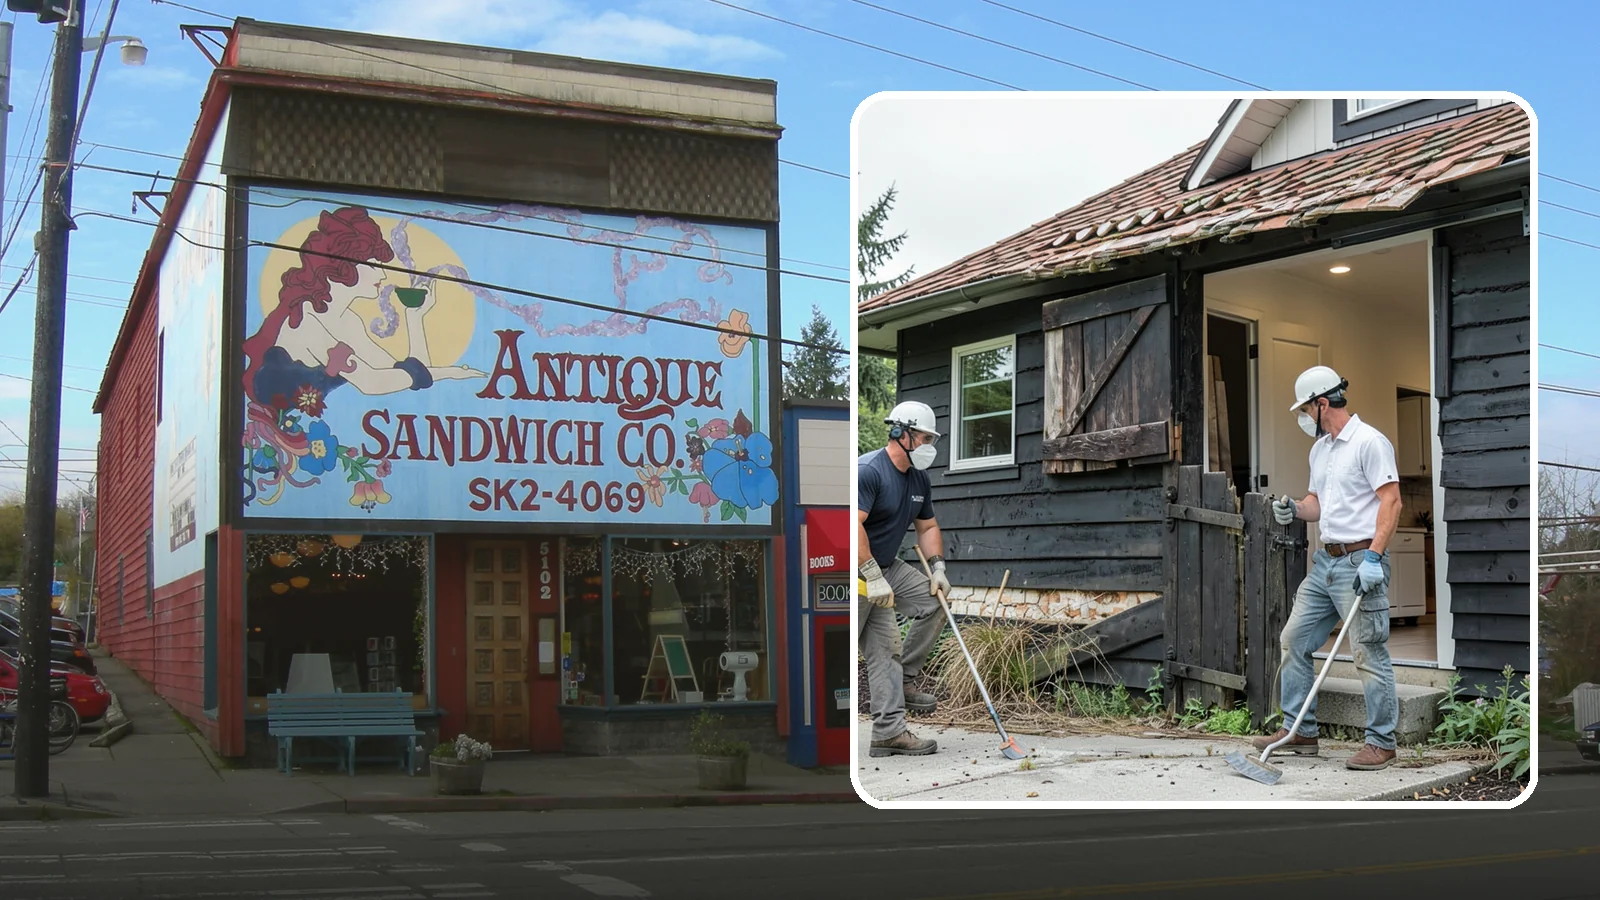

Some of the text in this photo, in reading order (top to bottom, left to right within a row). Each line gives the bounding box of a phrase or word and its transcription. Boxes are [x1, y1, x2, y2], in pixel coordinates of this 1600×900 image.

[476, 329, 724, 420] ANTIQUE
[361, 408, 686, 468] SANDWICH CO.
[468, 476, 646, 513] SK2-4069
[539, 541, 552, 600] 5102
[809, 555, 834, 569] BOOKS
